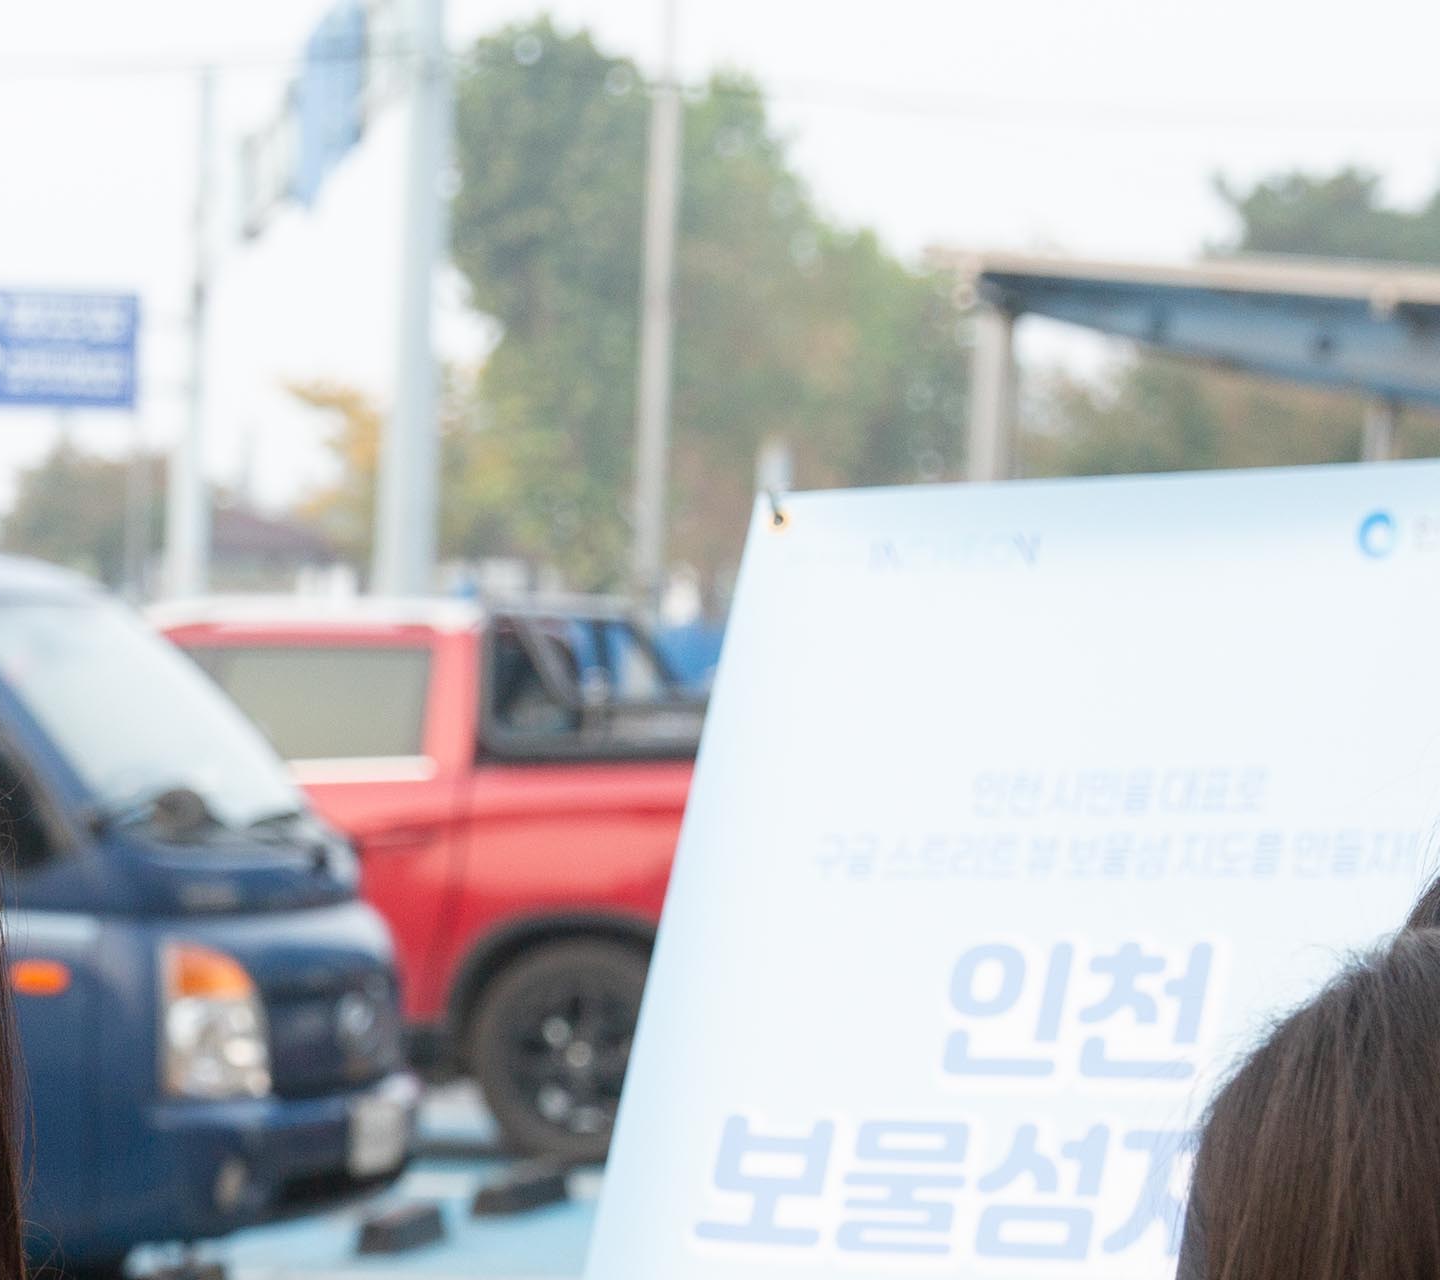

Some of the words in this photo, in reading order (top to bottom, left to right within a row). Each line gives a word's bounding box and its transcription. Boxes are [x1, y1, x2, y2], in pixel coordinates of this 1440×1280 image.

[971, 768, 1043, 819] 인천
[1159, 764, 1272, 816] 대표로
[814, 832, 880, 881] 구글
[882, 831, 1021, 881] 스트리트
[942, 940, 1214, 1081] 인천
